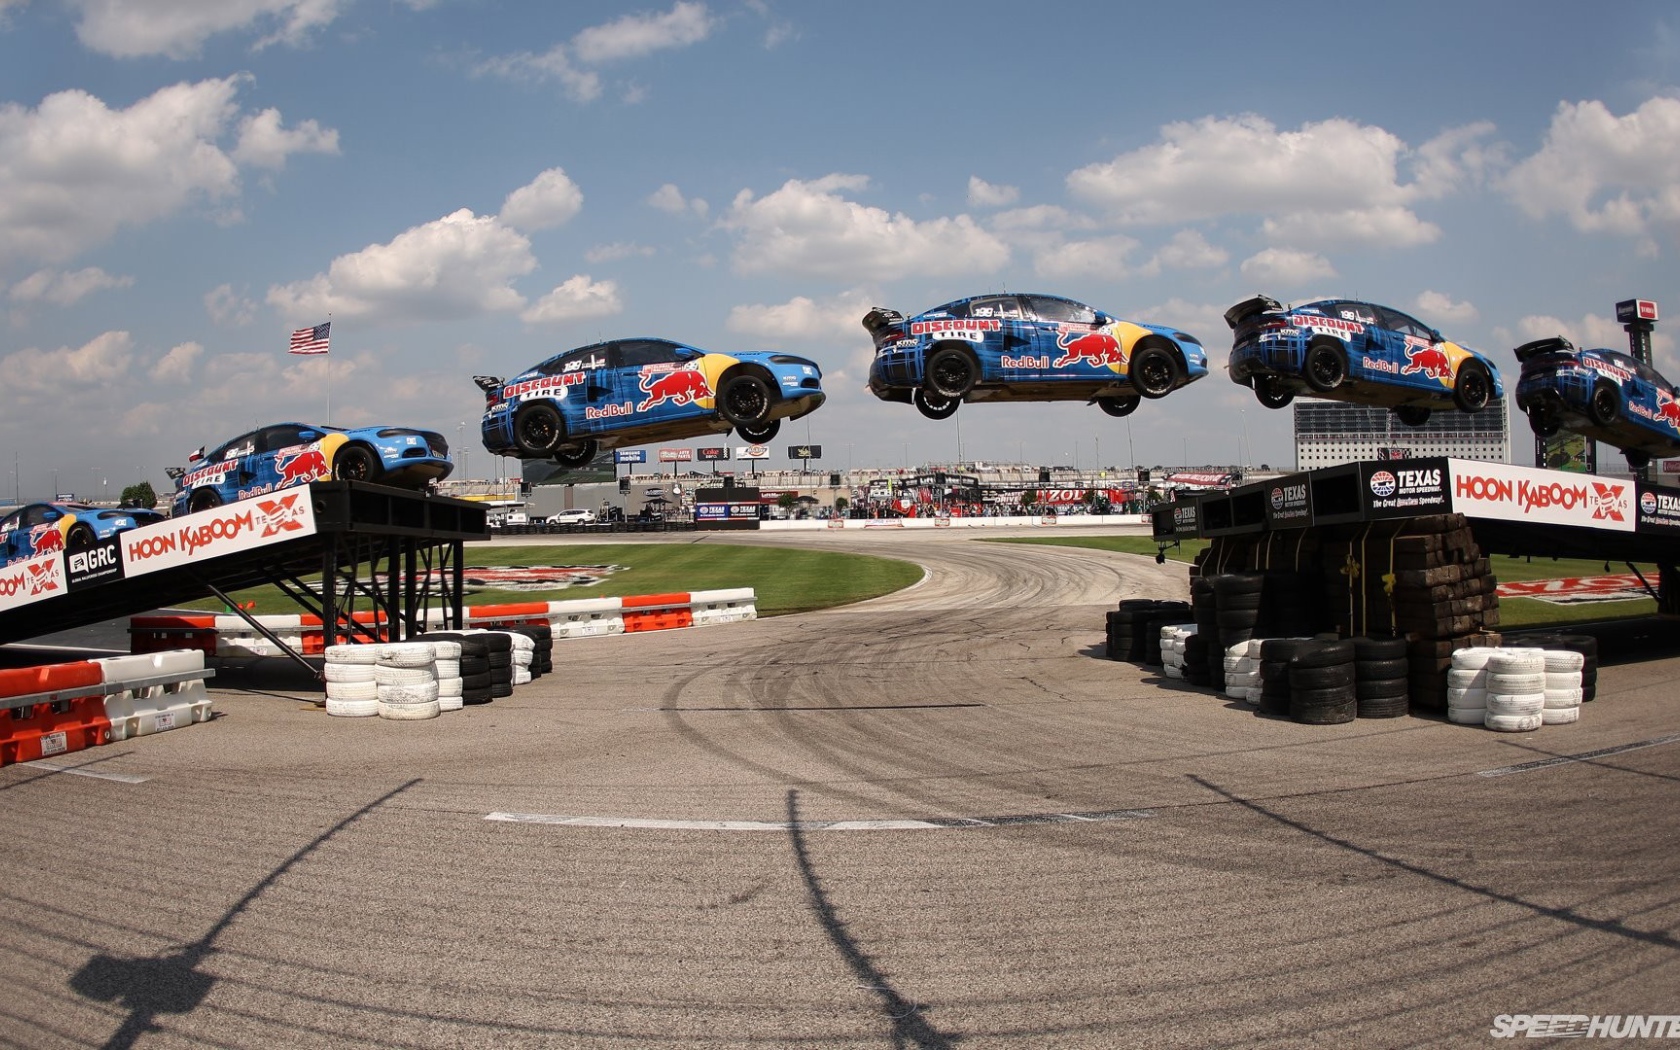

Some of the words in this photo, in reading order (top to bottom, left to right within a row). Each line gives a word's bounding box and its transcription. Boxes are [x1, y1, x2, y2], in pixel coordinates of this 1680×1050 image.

[974, 307, 993, 317] 199
[911, 319, 1001, 335] DISCOUNT
[1292, 315, 1364, 334] DISCOUNT
[1318, 326, 1346, 339] TIRE
[940, 331, 978, 340] TIRE
[1582, 357, 1632, 381] DISCOUNT
[503, 372, 586, 399] DISCOUNT
[526, 388, 562, 398] TIRE
[183, 459, 239, 487] DISCOUNT
[195, 475, 221, 485] TIRE
[1397, 469, 1441, 487] TEXAS
[1284, 484, 1306, 501] TEXAS
[1456, 474, 1512, 501] HOON
[1518, 480, 1587, 513] KABOOM
[1373, 499, 1382, 508] The
[1657, 495, 1680, 510] TEXA
[128, 532, 176, 562] HOON
[179, 510, 254, 556] KABOOM
[88, 544, 116, 569] GRC
